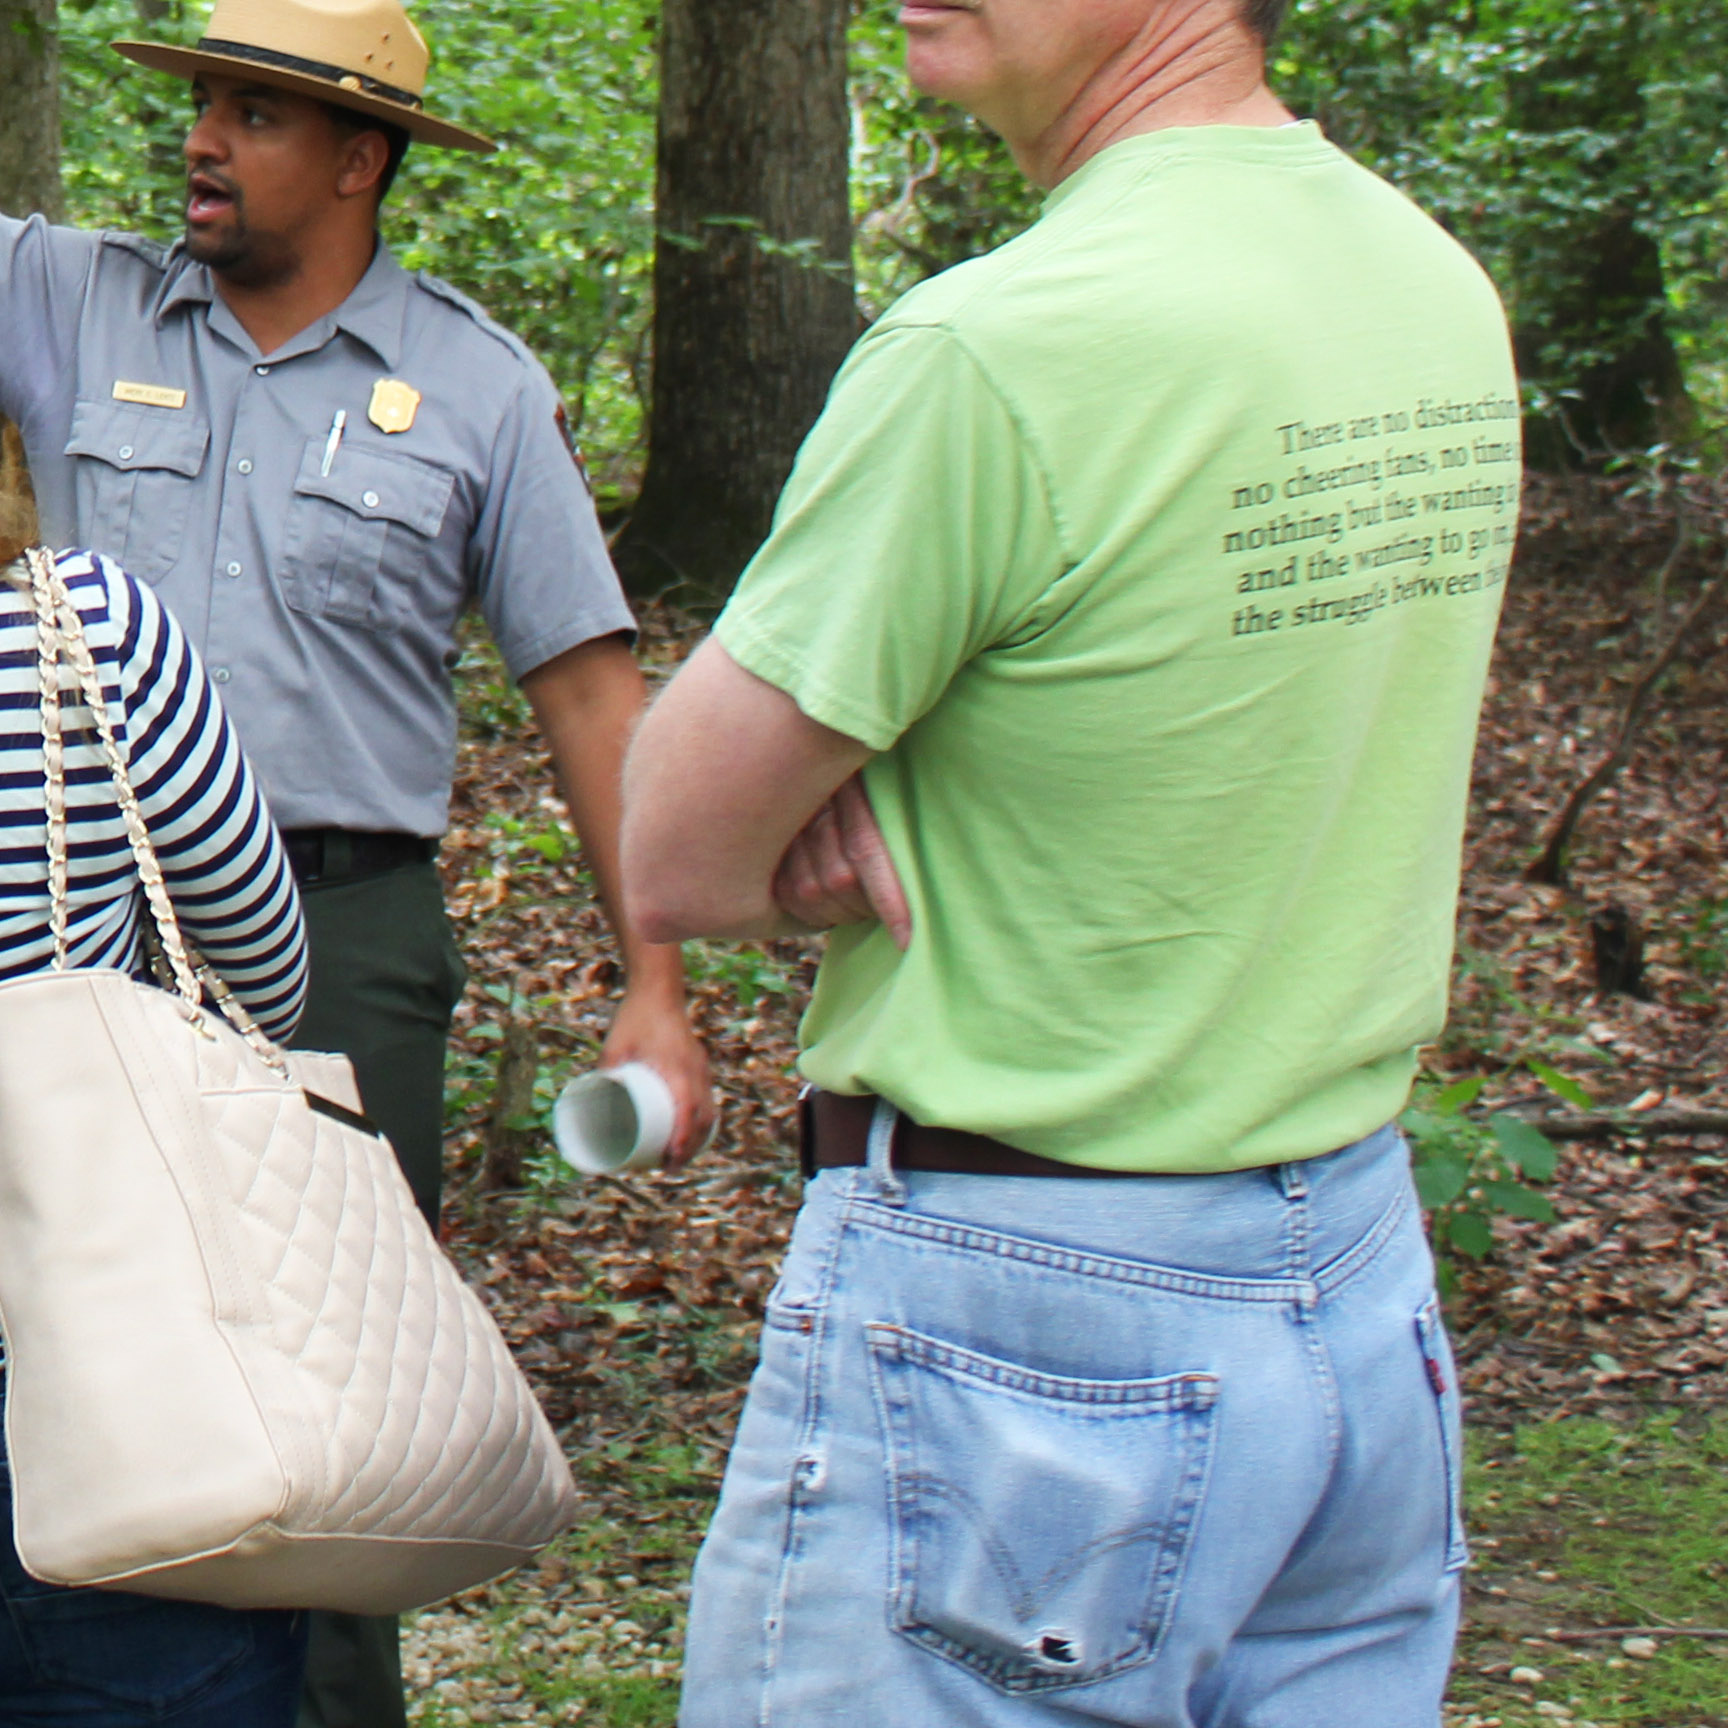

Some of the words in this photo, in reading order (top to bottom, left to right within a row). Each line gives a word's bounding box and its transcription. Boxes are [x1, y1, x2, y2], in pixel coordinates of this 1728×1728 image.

[1275, 421, 1343, 455] There
[1347, 415, 1379, 440] are
[1382, 411, 1409, 434] no
[1232, 482, 1274, 509] no
[1282, 455, 1380, 499] cheering
[1384, 447, 1436, 478] fans,
[1440, 446, 1467, 469] no
[1222, 510, 1342, 553] nothing
[1346, 499, 1382, 530] but
[1384, 491, 1416, 521] the
[1421, 479, 1504, 514] wanting
[1237, 555, 1298, 595] and
[1306, 549, 1349, 581] the
[1354, 533, 1432, 572] wanting
[1440, 528, 1463, 554] to
[1468, 529, 1488, 560] go
[1232, 603, 1283, 637] the
[1291, 582, 1387, 626] struggle
[1391, 572, 1481, 605] between
